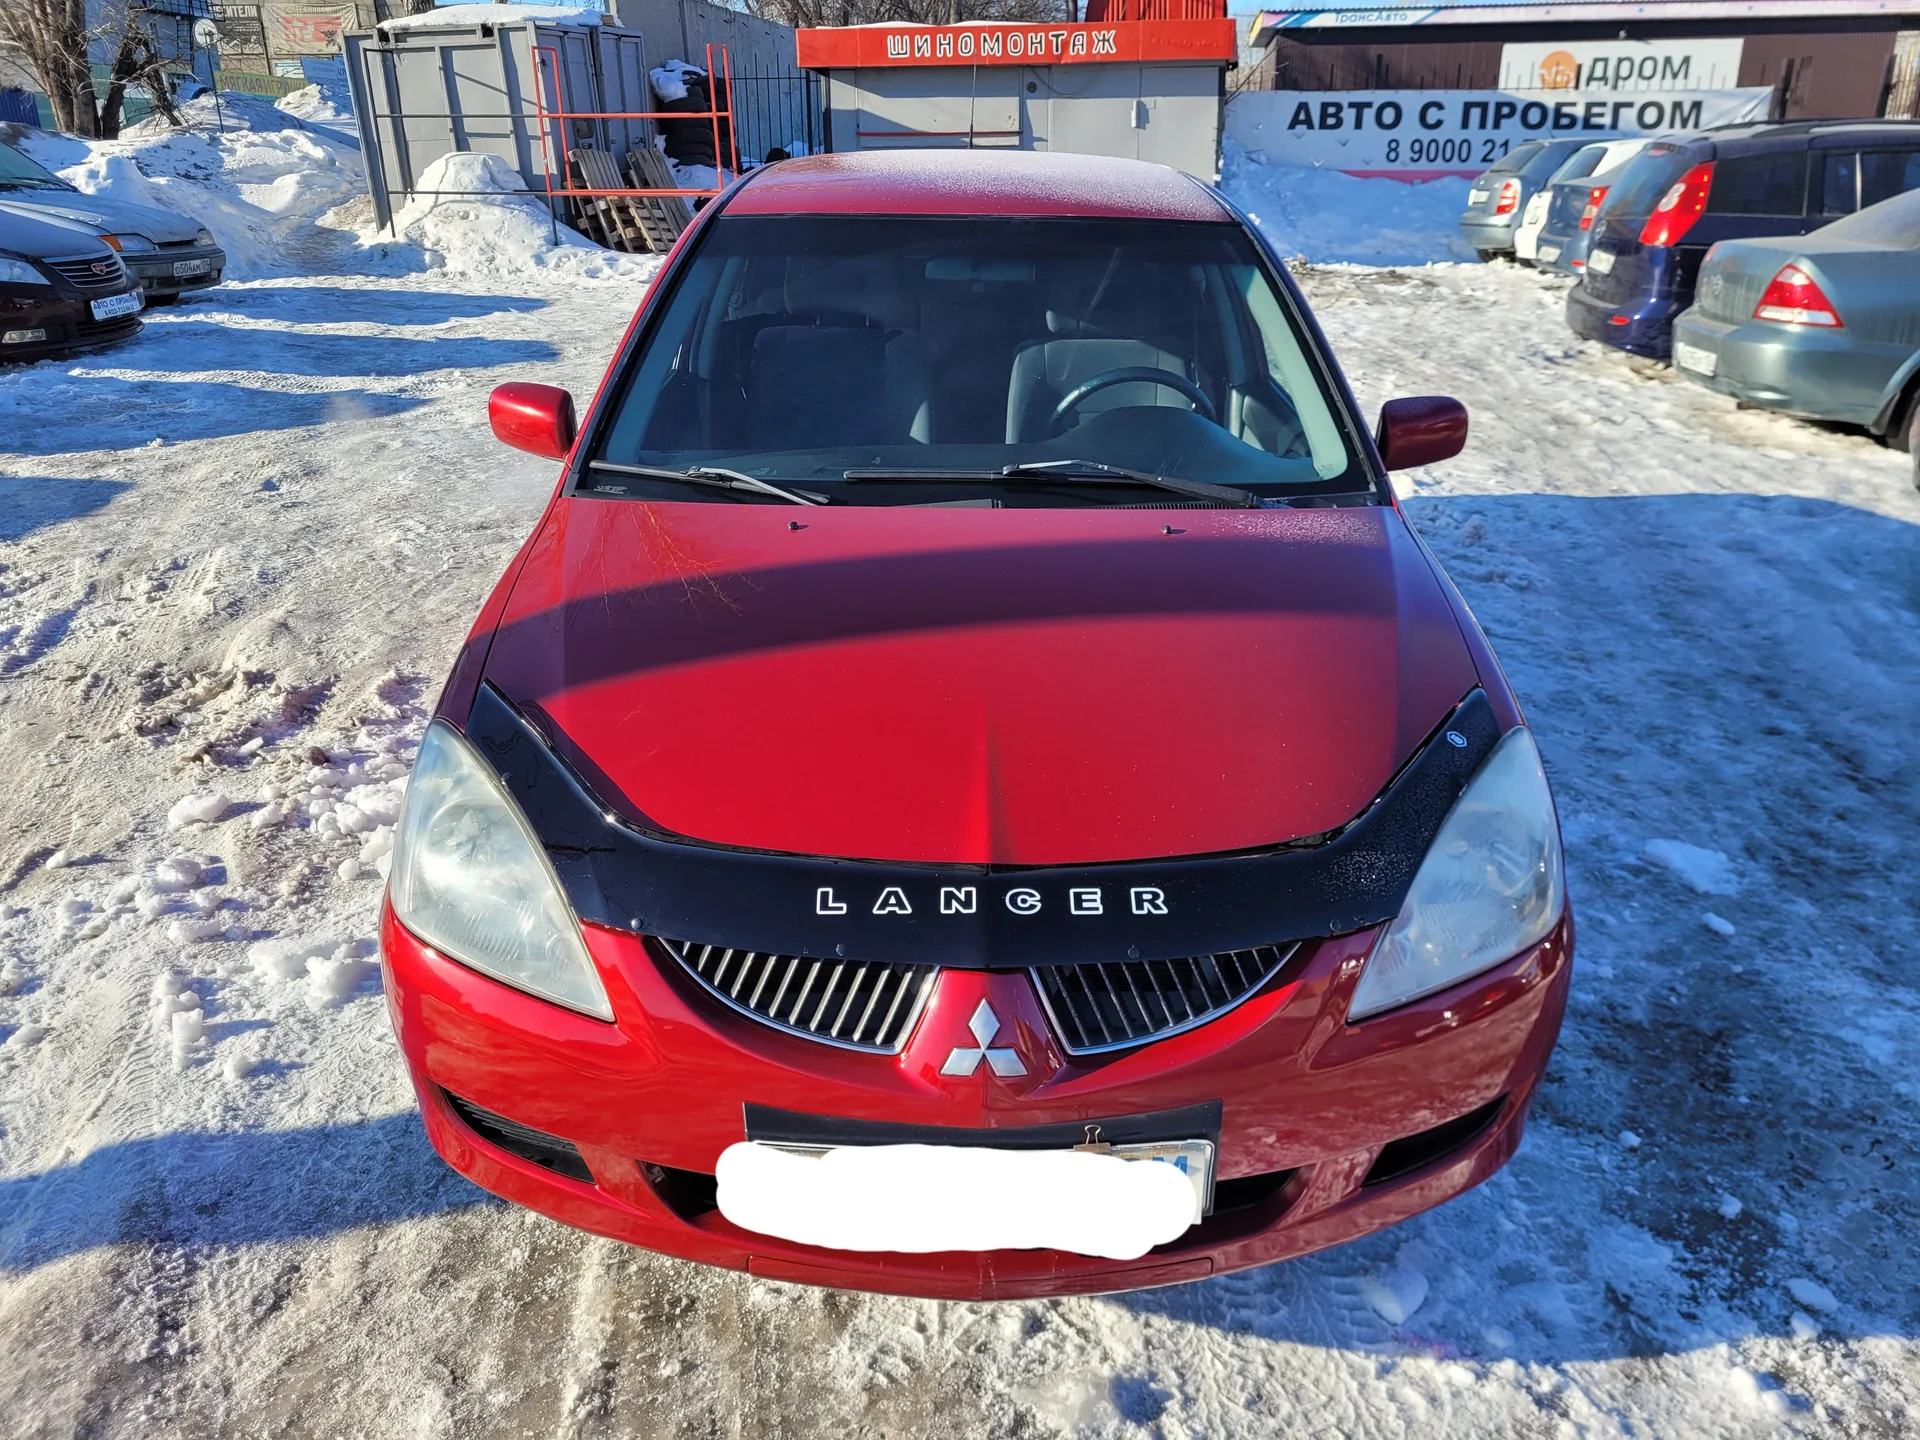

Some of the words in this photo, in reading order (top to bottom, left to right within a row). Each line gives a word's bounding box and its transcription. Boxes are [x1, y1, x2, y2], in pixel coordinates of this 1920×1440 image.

[886, 29, 1117, 58] ШИНОМОНТАЖ
[219, 74, 263, 92] МЯГКАЯ
[1286, 101, 1403, 131] АВТО
[1418, 101, 1446, 131] С
[1460, 100, 1704, 131] ПРОБЕГОМ
[1386, 138, 1400, 164] 8
[1409, 138, 1472, 164] 9000
[1480, 138, 1511, 163] 21
[93, 300, 109, 311] АВТО
[815, 886, 1169, 915] LANCER
